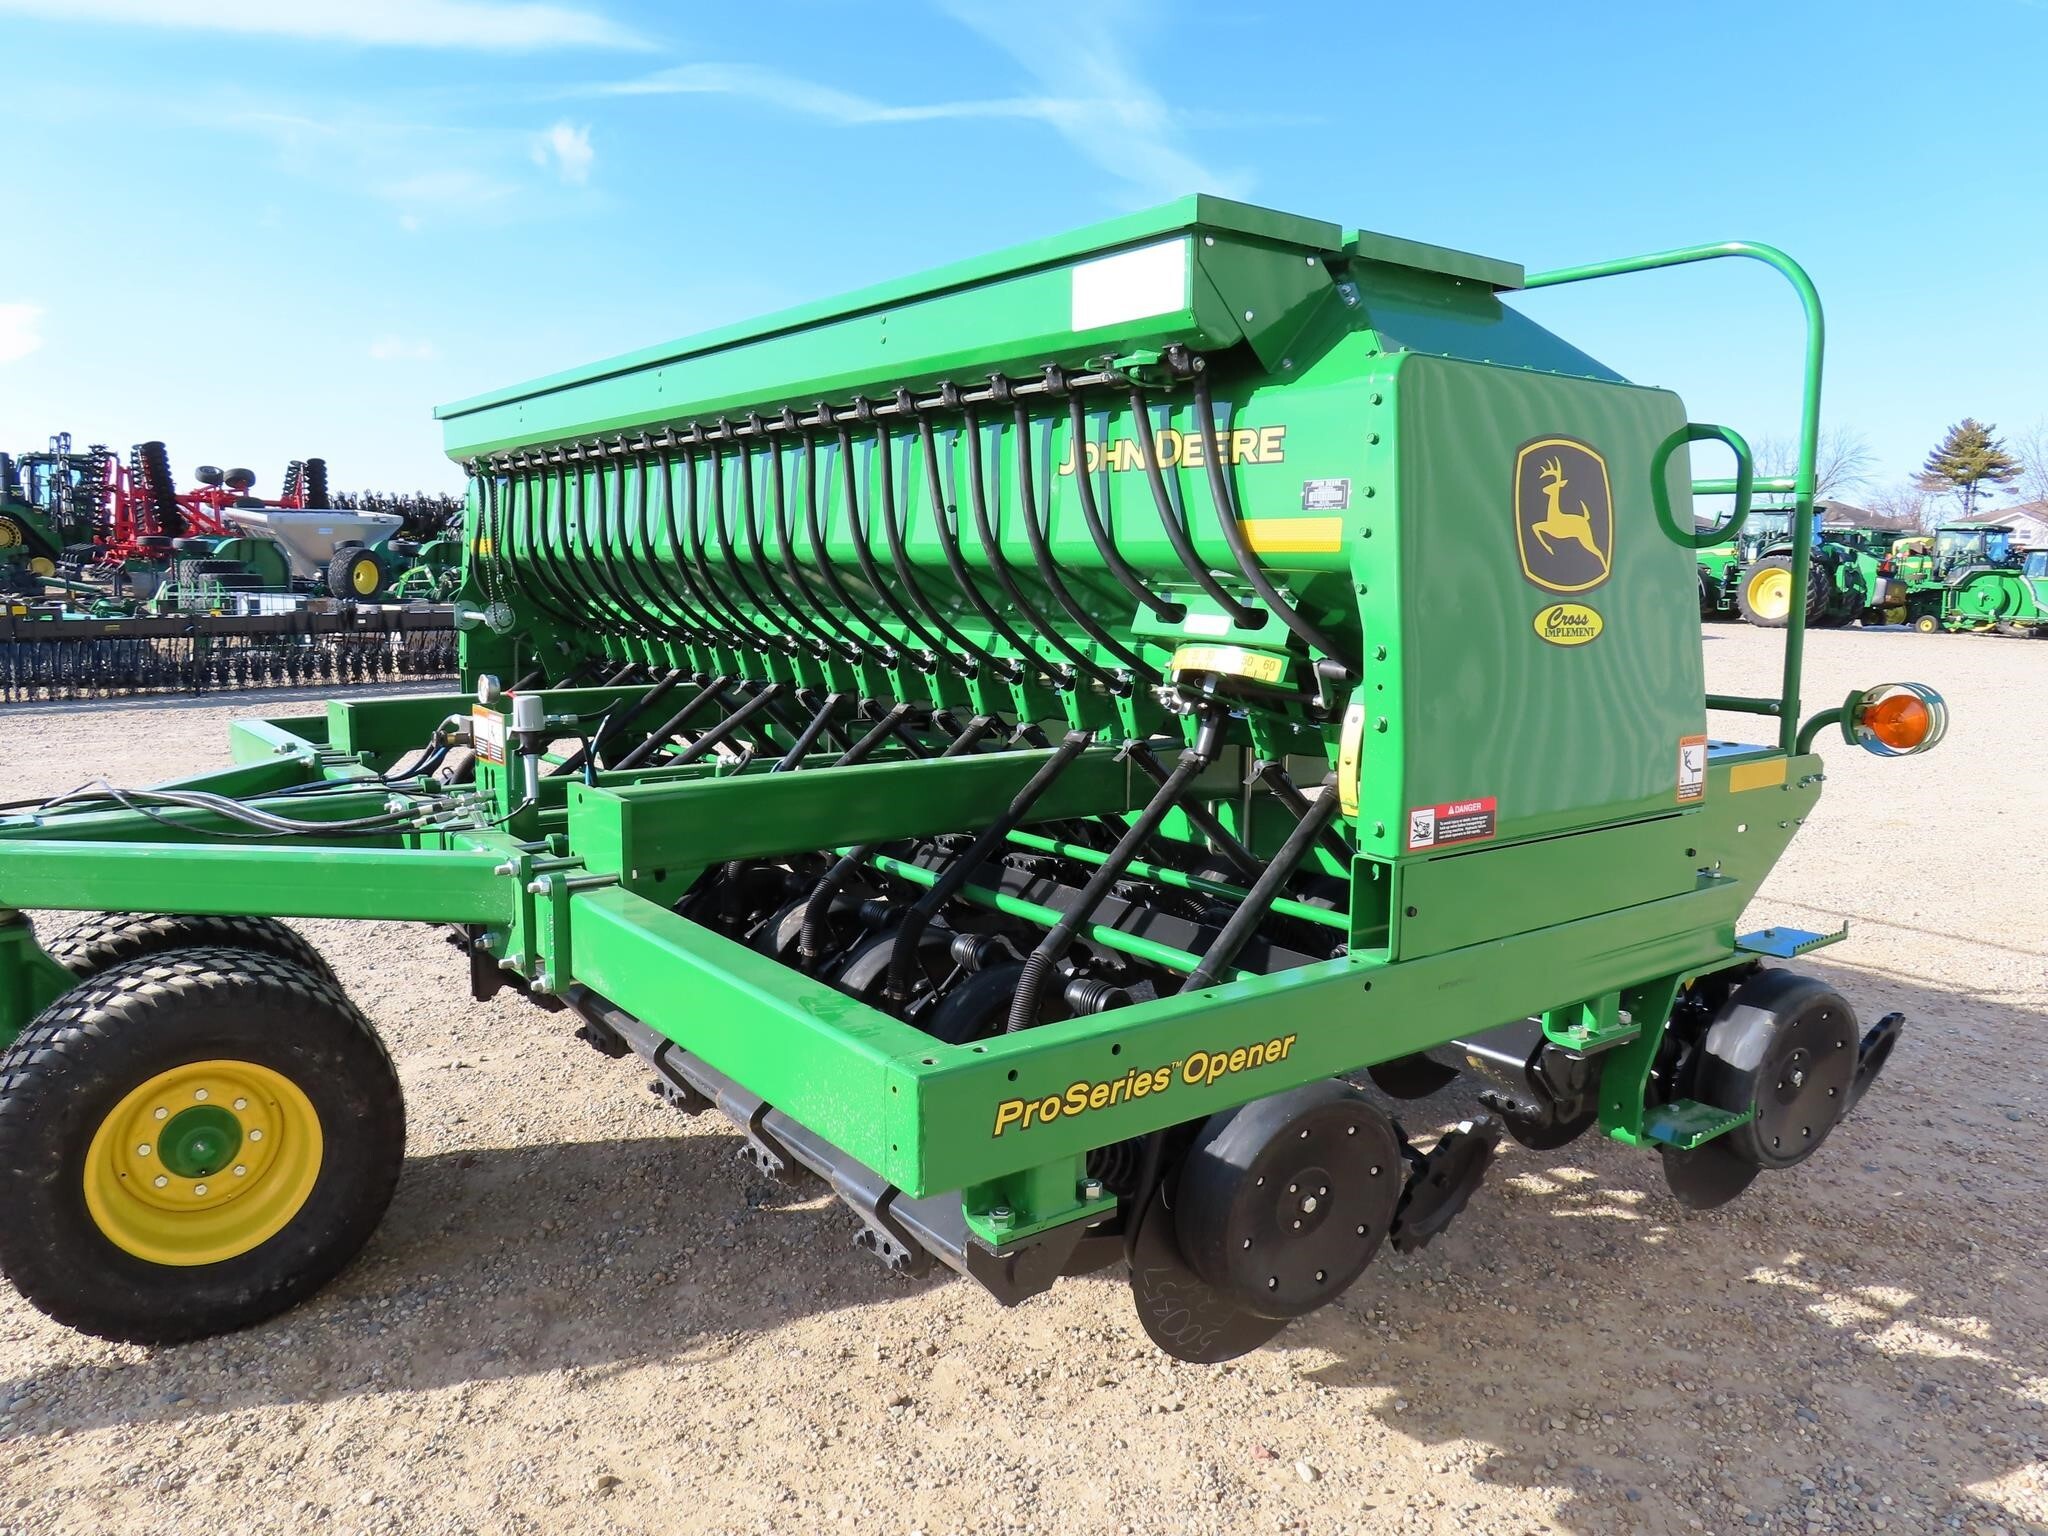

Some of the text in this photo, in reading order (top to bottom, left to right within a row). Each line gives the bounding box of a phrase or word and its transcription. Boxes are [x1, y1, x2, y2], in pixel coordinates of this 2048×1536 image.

[1546, 606, 1589, 629] Cross
[1544, 627, 1595, 638] IMPLEMENT
[1263, 659, 1276, 671] 60
[1455, 802, 1482, 813] DANGER
[1182, 1033, 1297, 1087] Opener
